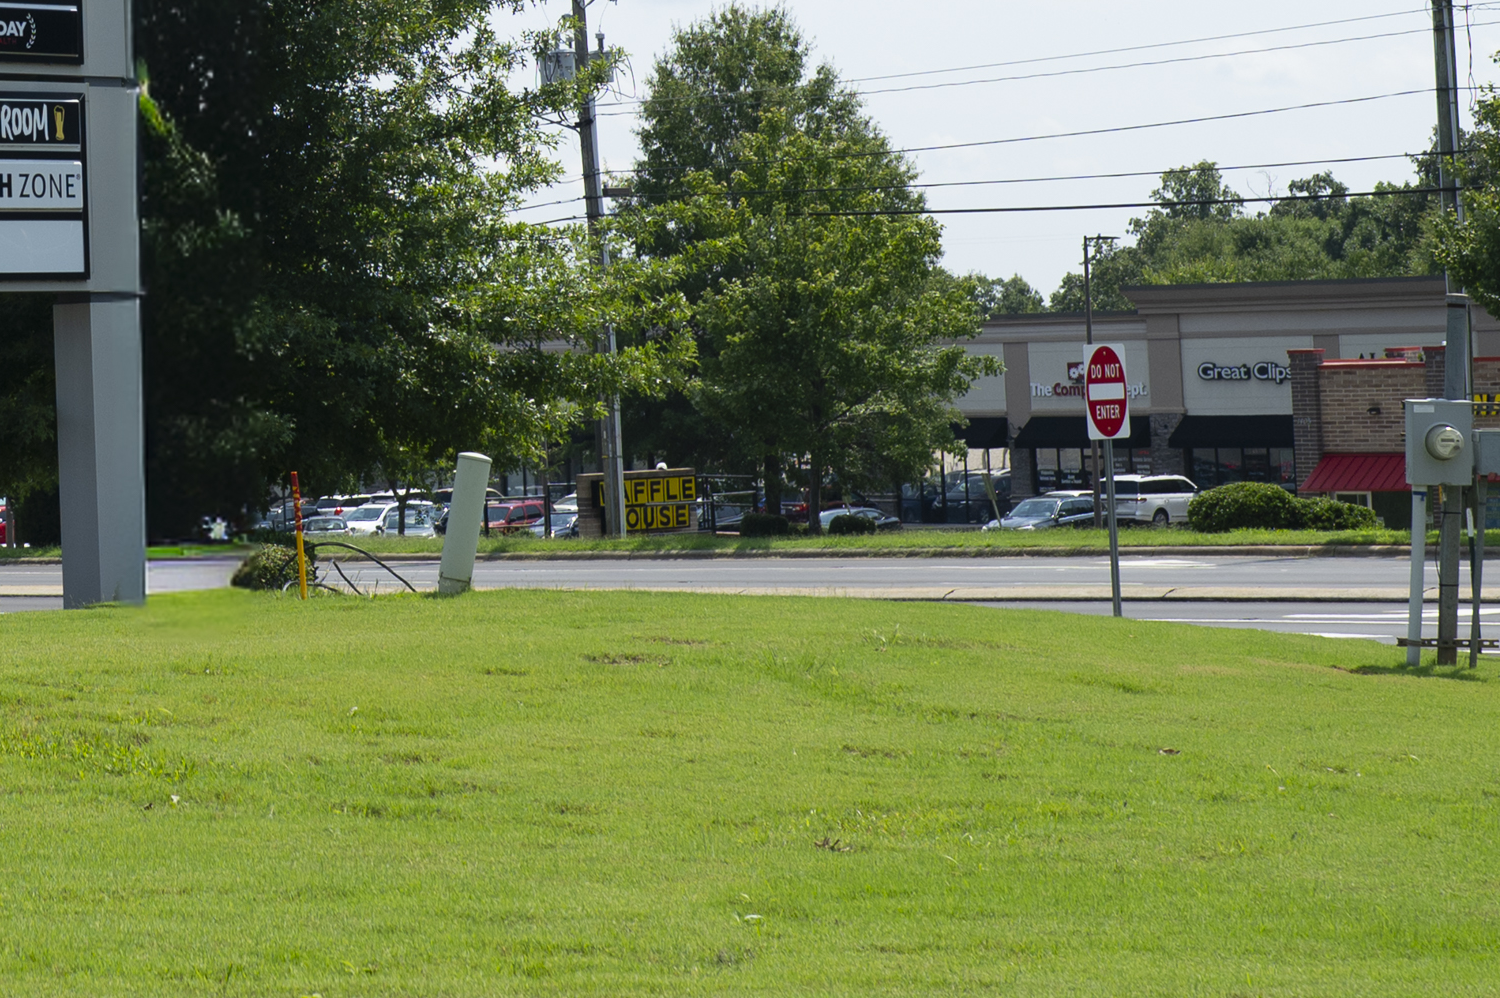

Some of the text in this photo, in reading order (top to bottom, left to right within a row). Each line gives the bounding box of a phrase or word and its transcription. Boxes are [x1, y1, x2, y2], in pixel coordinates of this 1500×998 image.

[1091, 364, 1120, 378] DO NOT
[1199, 363, 1248, 379] Great
[1030, 383, 1052, 396] The
[1096, 405, 1120, 420] ENTER
